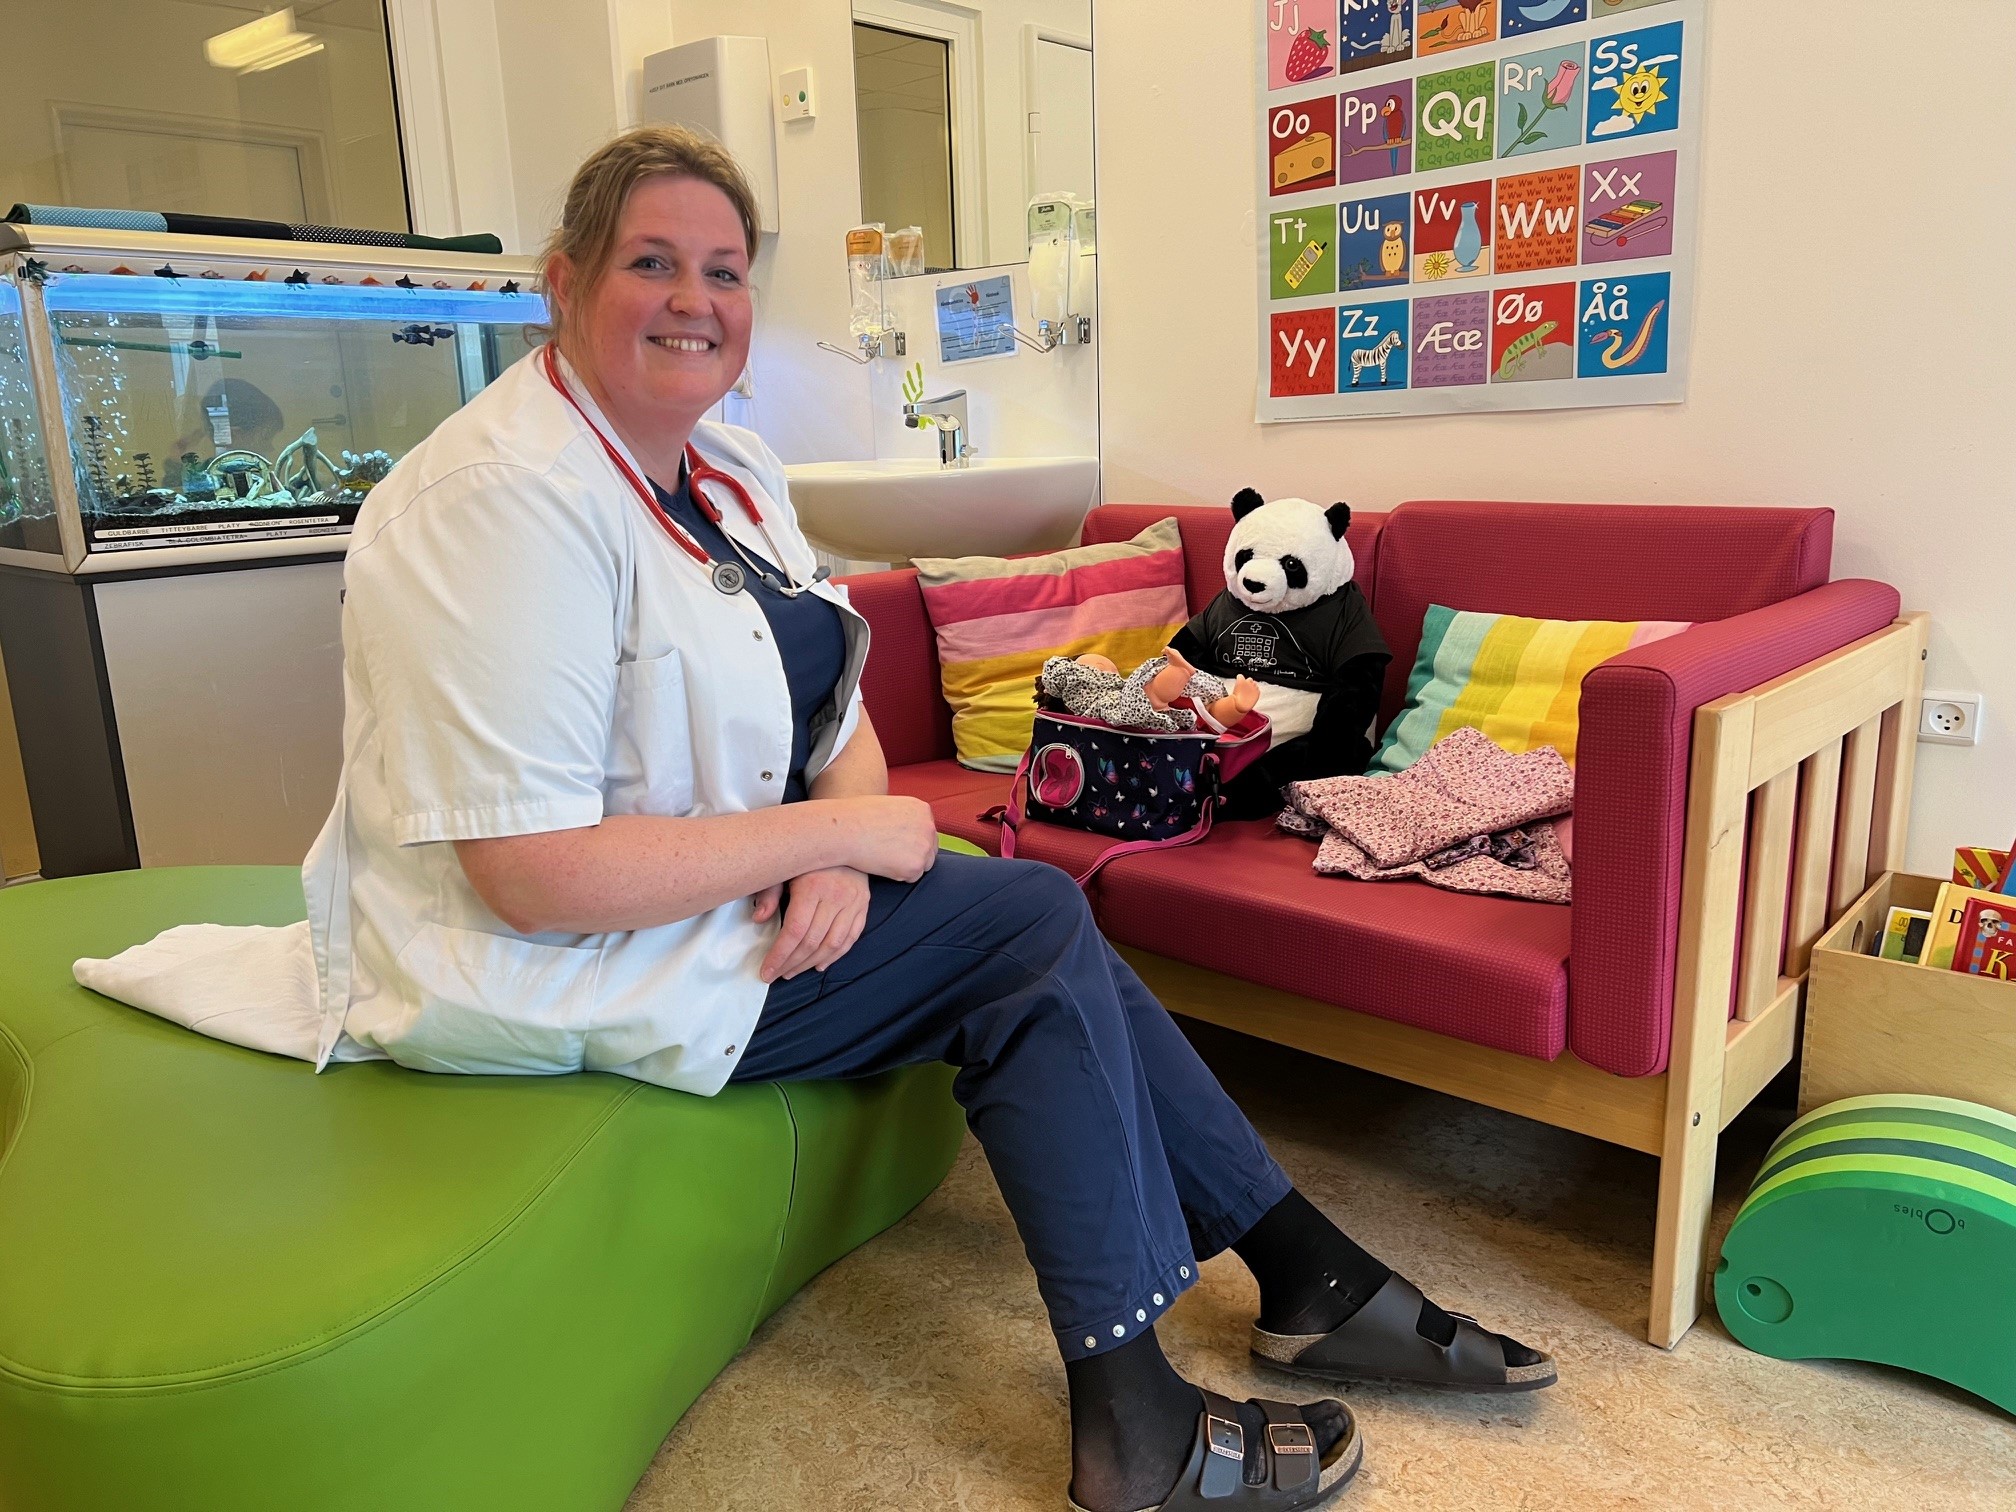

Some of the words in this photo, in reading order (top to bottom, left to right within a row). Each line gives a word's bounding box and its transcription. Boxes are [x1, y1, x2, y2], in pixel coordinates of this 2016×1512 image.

[1270, 0, 1299, 35] Jj
[1592, 40, 1638, 75] Ss
[1503, 62, 1545, 96] Rr
[1272, 109, 1310, 139] Oo
[1344, 96, 1377, 134] Pp
[1422, 91, 1487, 141] Qq
[1589, 167, 1643, 203] Xx
[1342, 203, 1380, 234] Uu
[1418, 192, 1456, 224] Vv
[1500, 199, 1575, 240] Ww
[1274, 218, 1307, 244] Tt
[1496, 292, 1543, 326] Øø
[1582, 281, 1629, 323] Åå
[1342, 309, 1379, 339] Zz
[1417, 321, 1483, 354] Ææ
[1279, 328, 1326, 378] Yy
[104, 541, 144, 549] ZEBRAFISK
[162, 525, 208, 533] TITTEYBARBE
